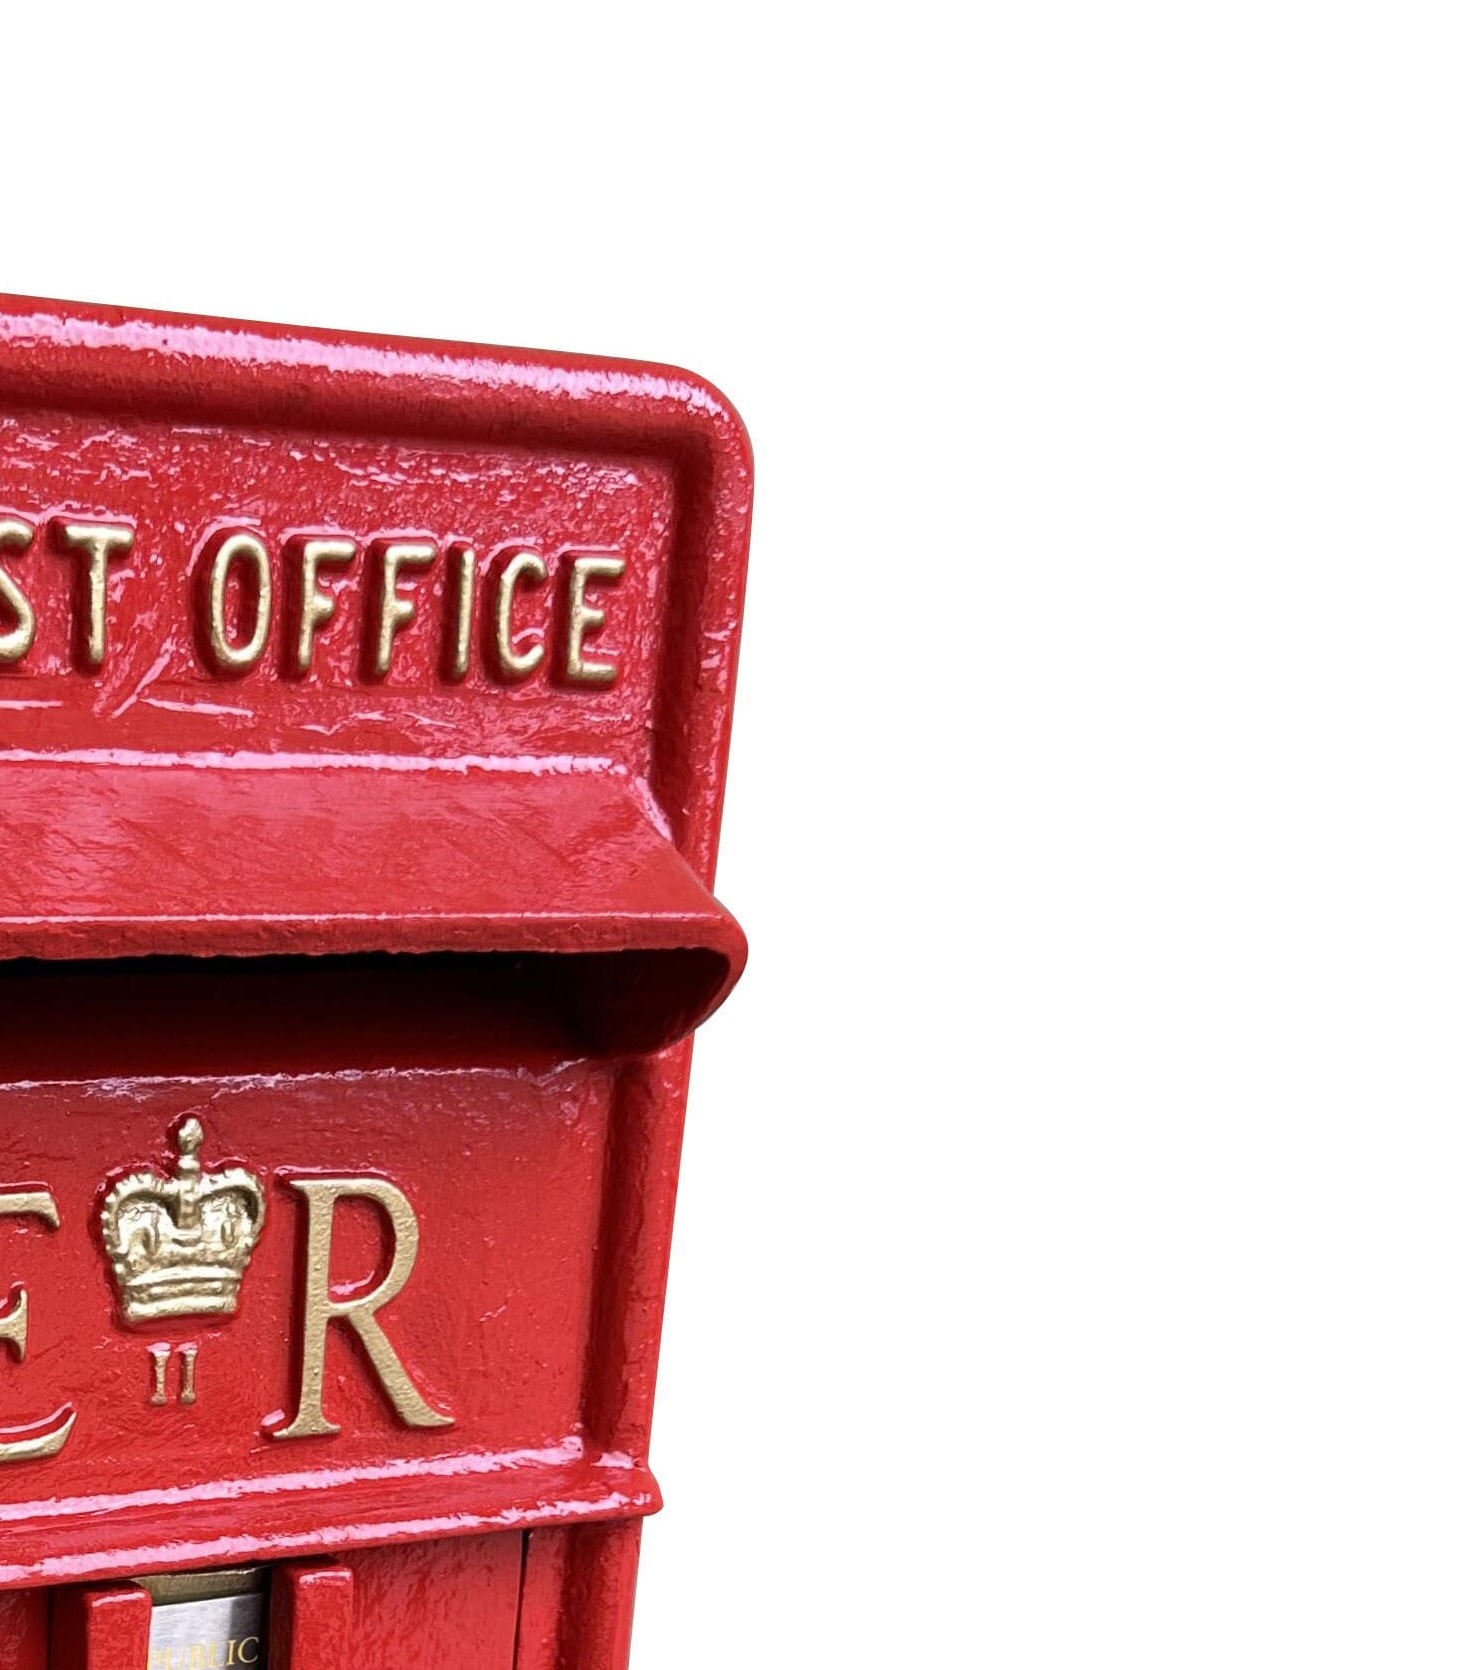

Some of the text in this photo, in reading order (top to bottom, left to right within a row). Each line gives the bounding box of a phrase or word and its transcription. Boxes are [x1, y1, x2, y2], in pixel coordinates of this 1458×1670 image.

[207, 532, 625, 684] OFFICE
[146, 1342, 198, 1406] II
[270, 1177, 455, 1441] R
